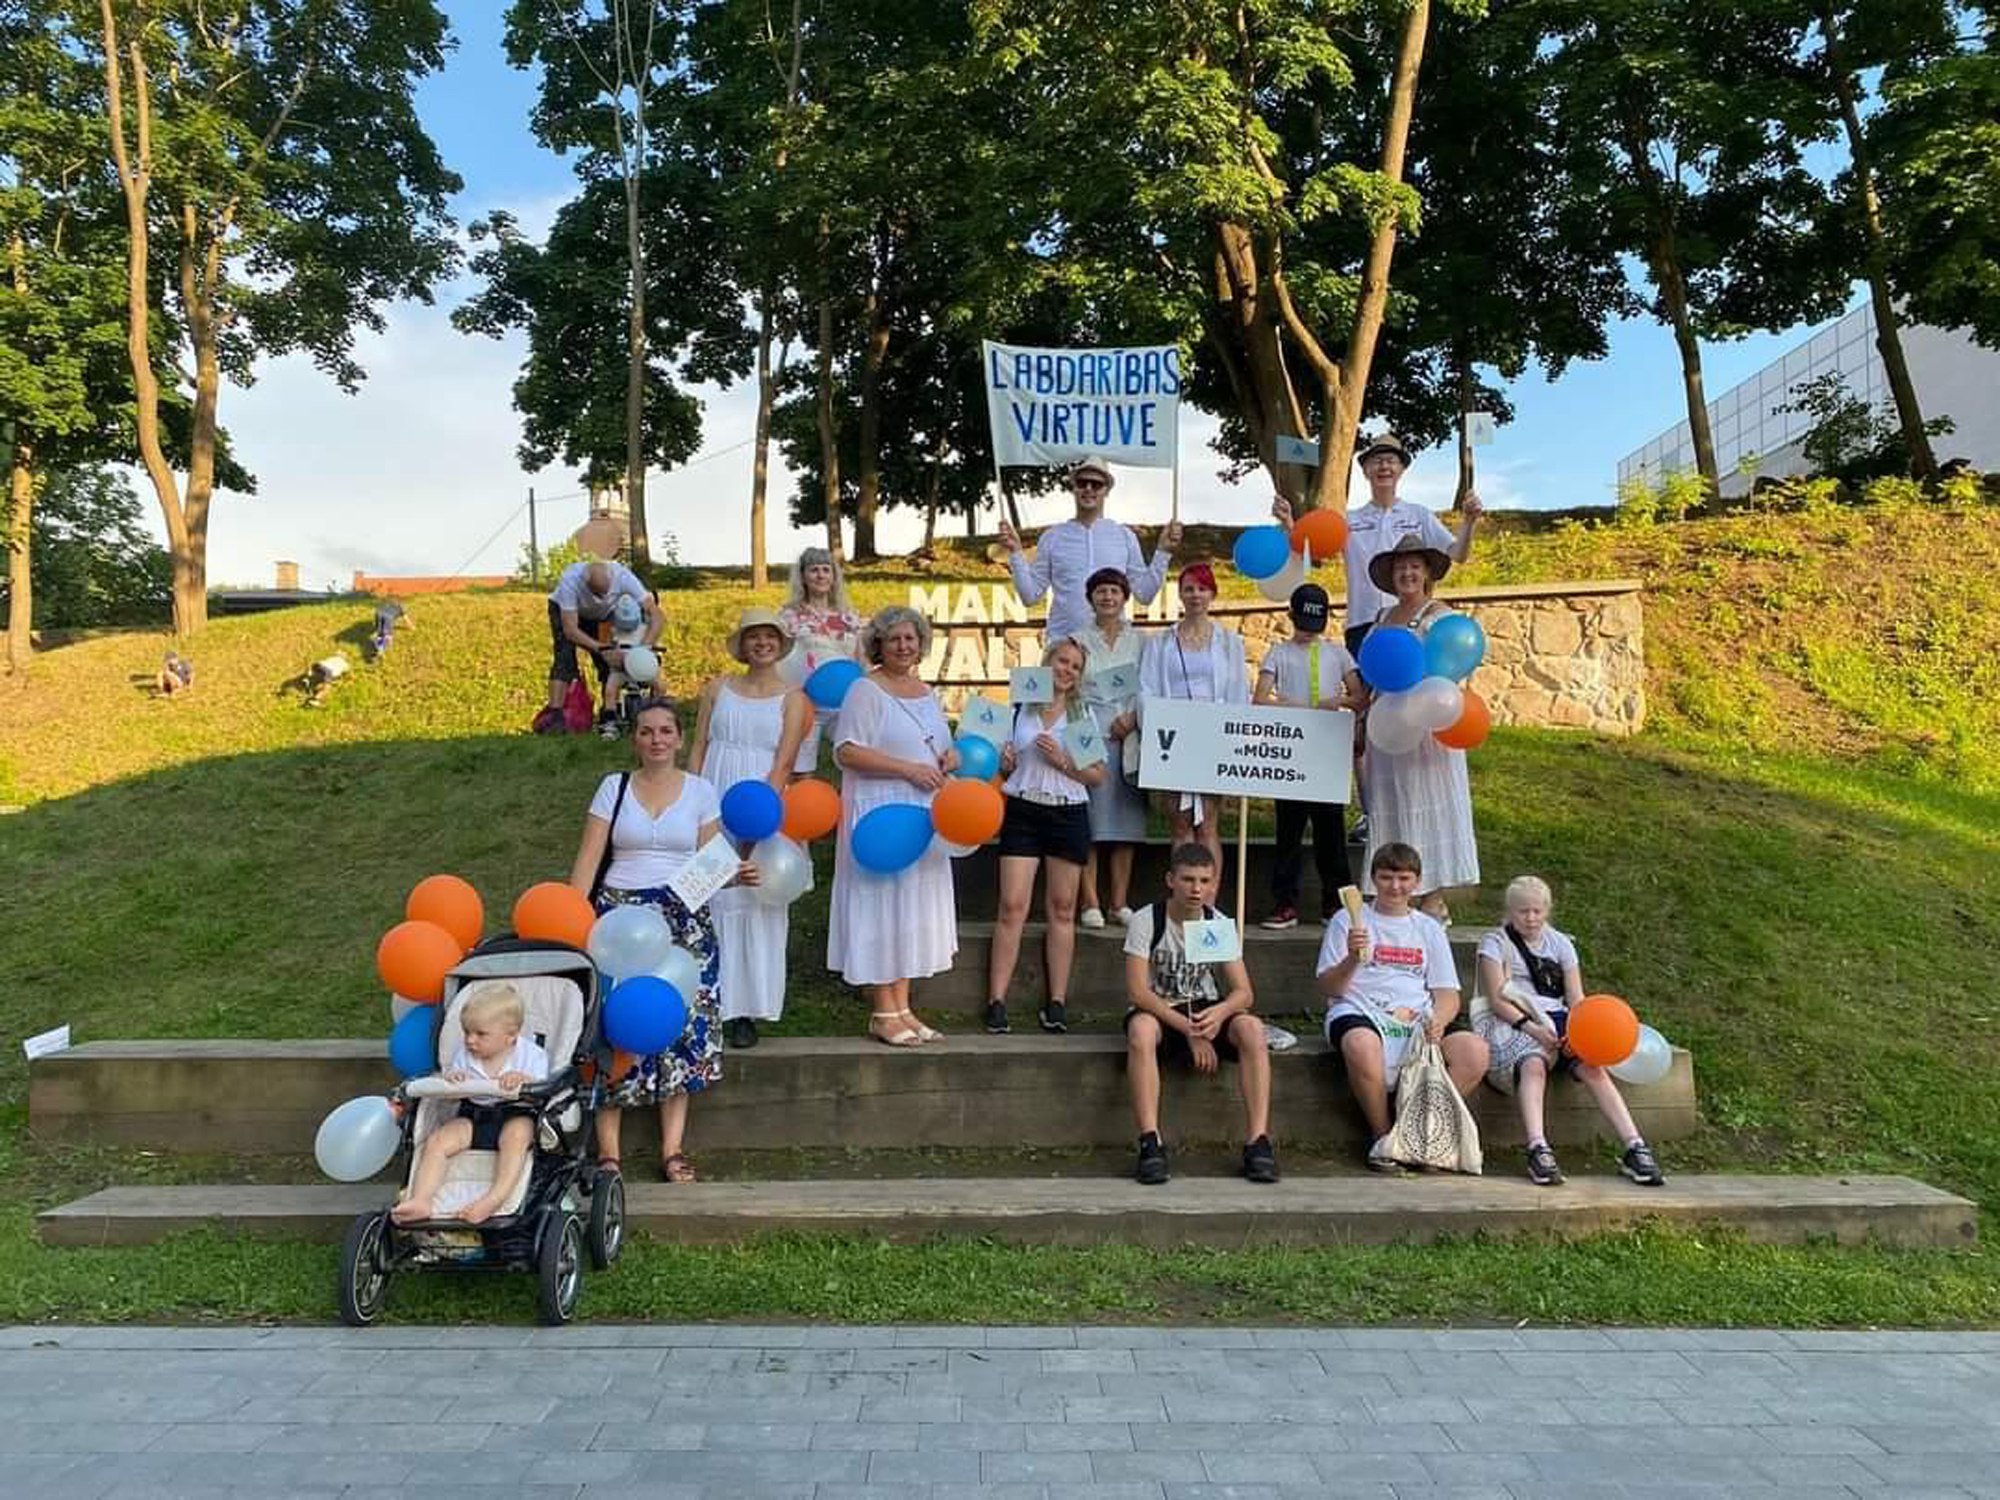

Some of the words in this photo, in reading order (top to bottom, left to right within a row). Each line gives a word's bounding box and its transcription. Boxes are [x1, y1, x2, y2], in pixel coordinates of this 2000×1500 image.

[992, 350, 1180, 395] LABDARĪBAS
[1012, 402, 1156, 447] VIRTUVE
[1224, 721, 1304, 740] BIEDRĪBA
[1234, 742, 1292, 760] «MŪSU
[1217, 763, 1306, 782] PAVARDS»
